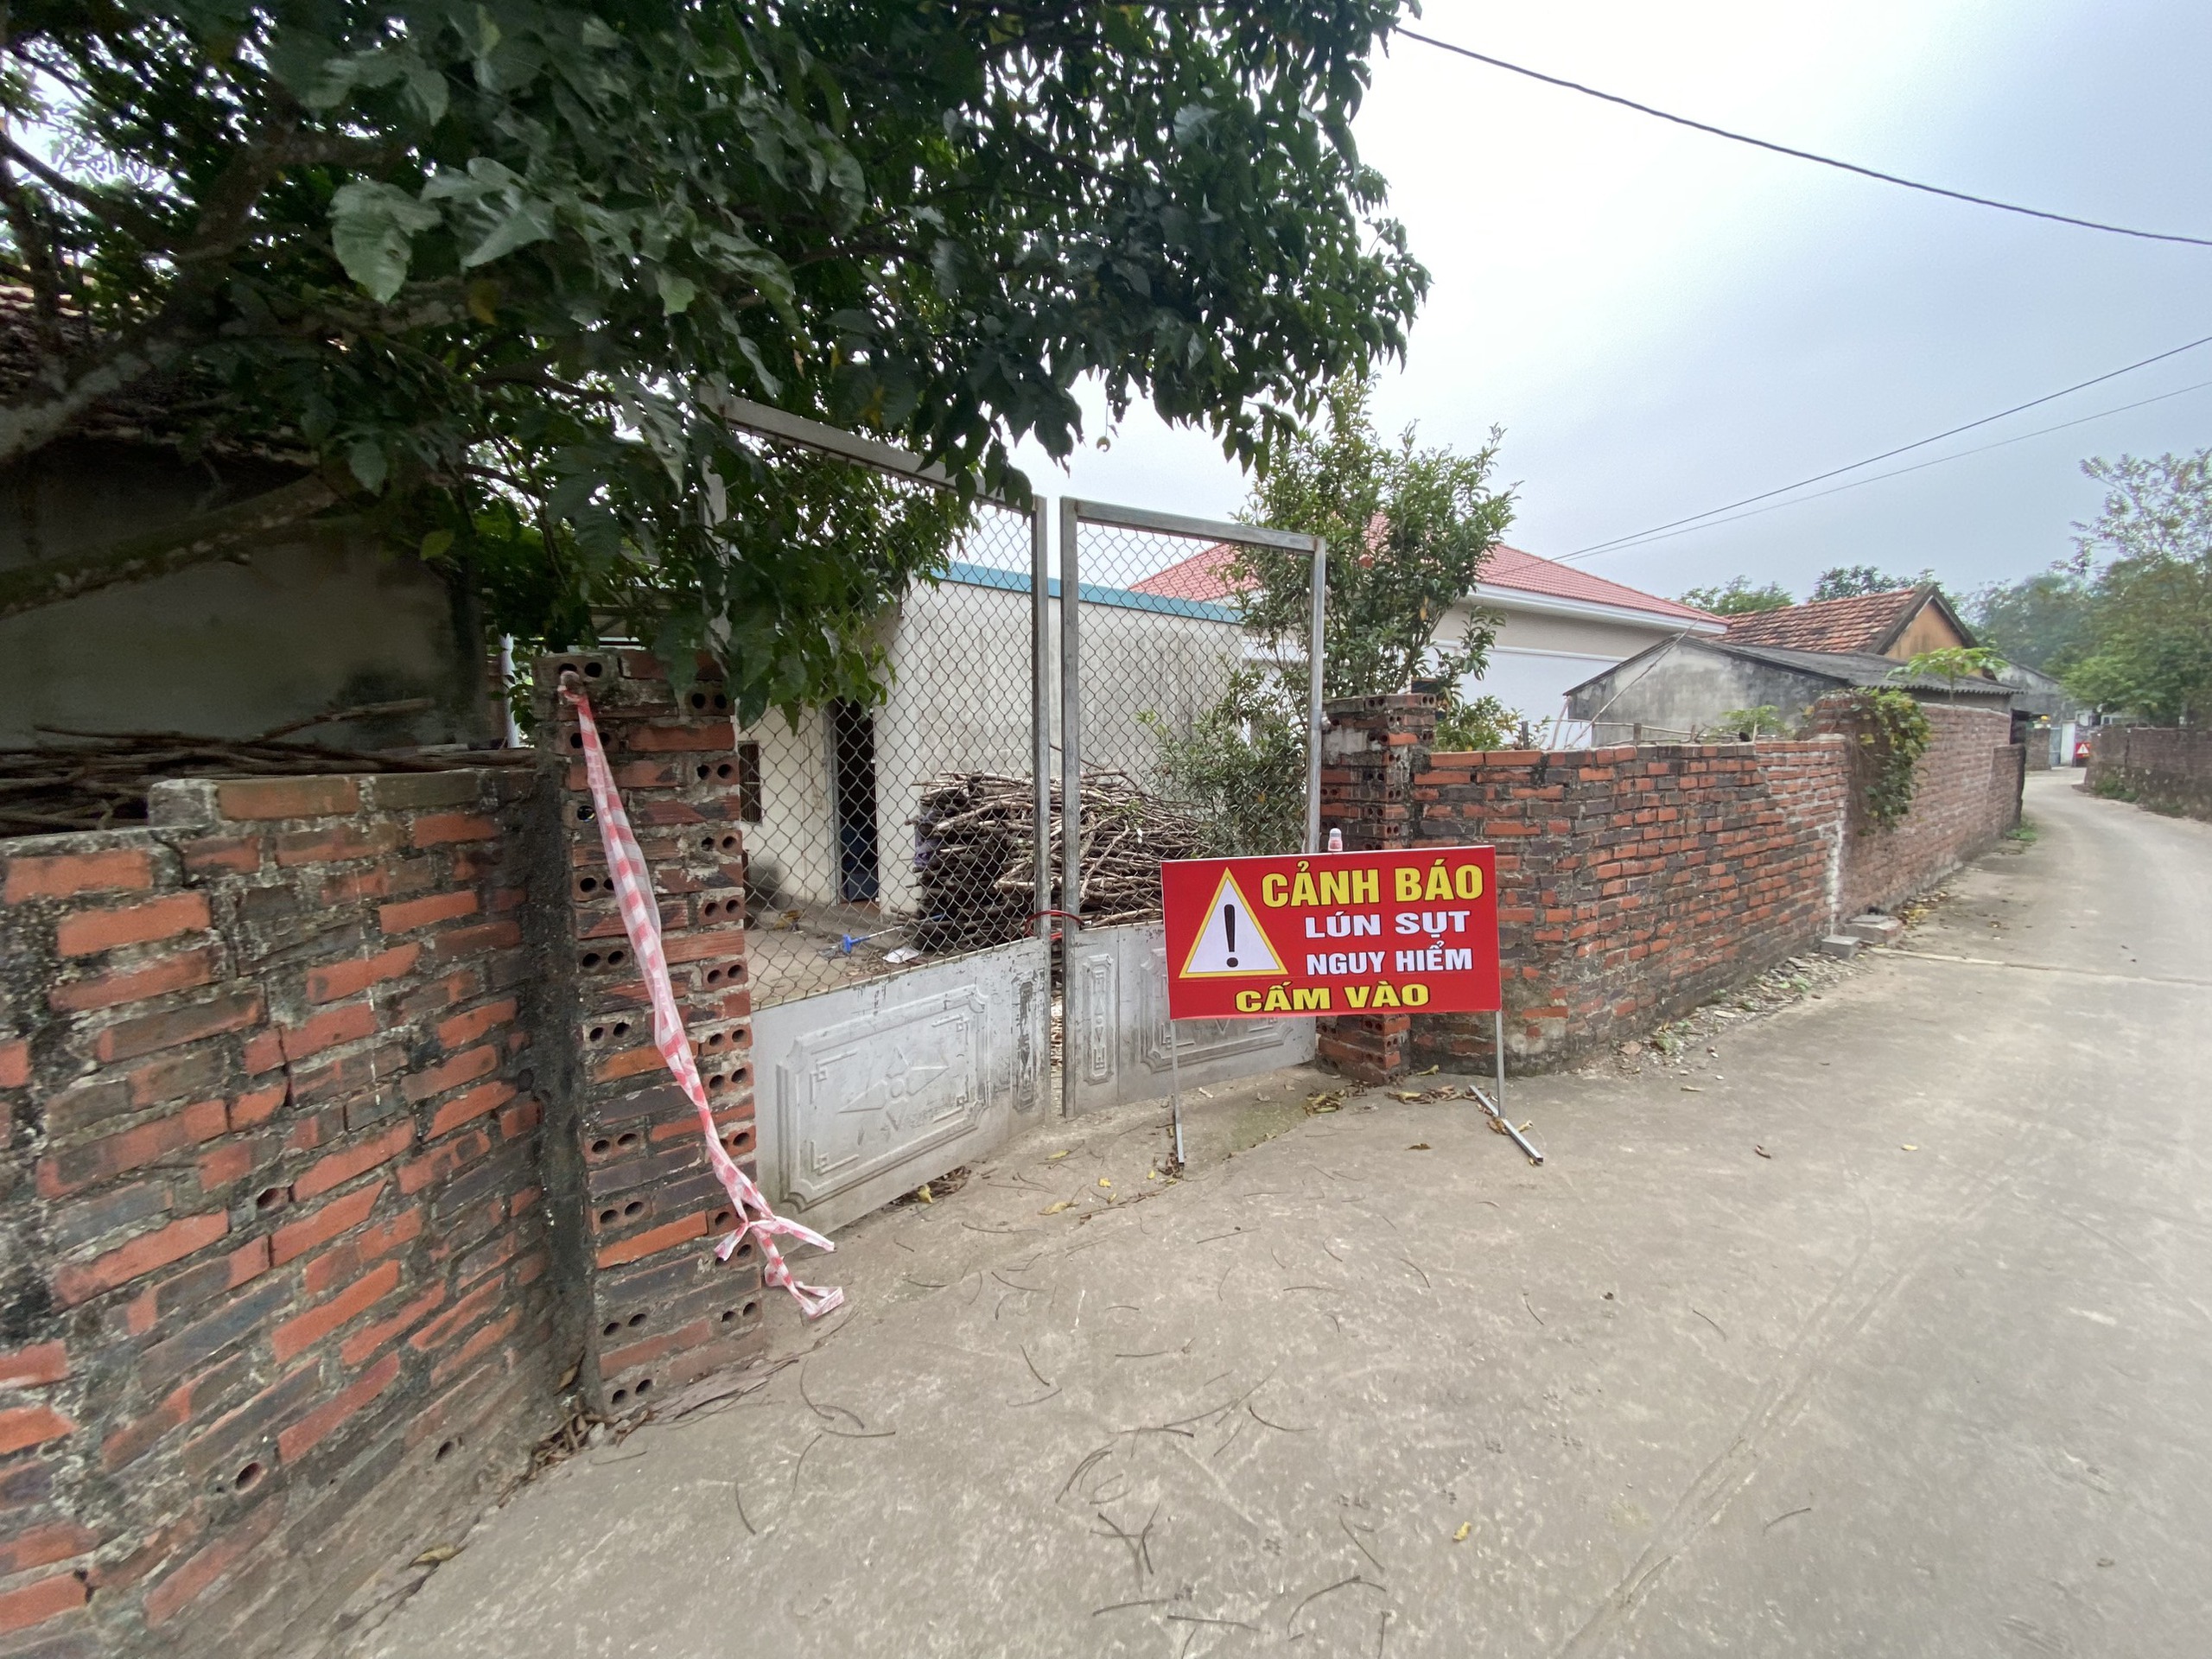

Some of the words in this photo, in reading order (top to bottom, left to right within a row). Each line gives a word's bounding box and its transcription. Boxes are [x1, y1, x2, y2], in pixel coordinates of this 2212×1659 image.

[1262, 860, 1380, 908] CẢNH
[1395, 858, 1484, 902] BÁO
[1305, 911, 1381, 938] LÚN
[1395, 910, 1471, 938] SỤT
[1306, 950, 1385, 976] NGUY
[1395, 940, 1472, 973] HIỂM
[1235, 981, 1331, 1013] CẤM
[1344, 980, 1430, 1009] VÀO
